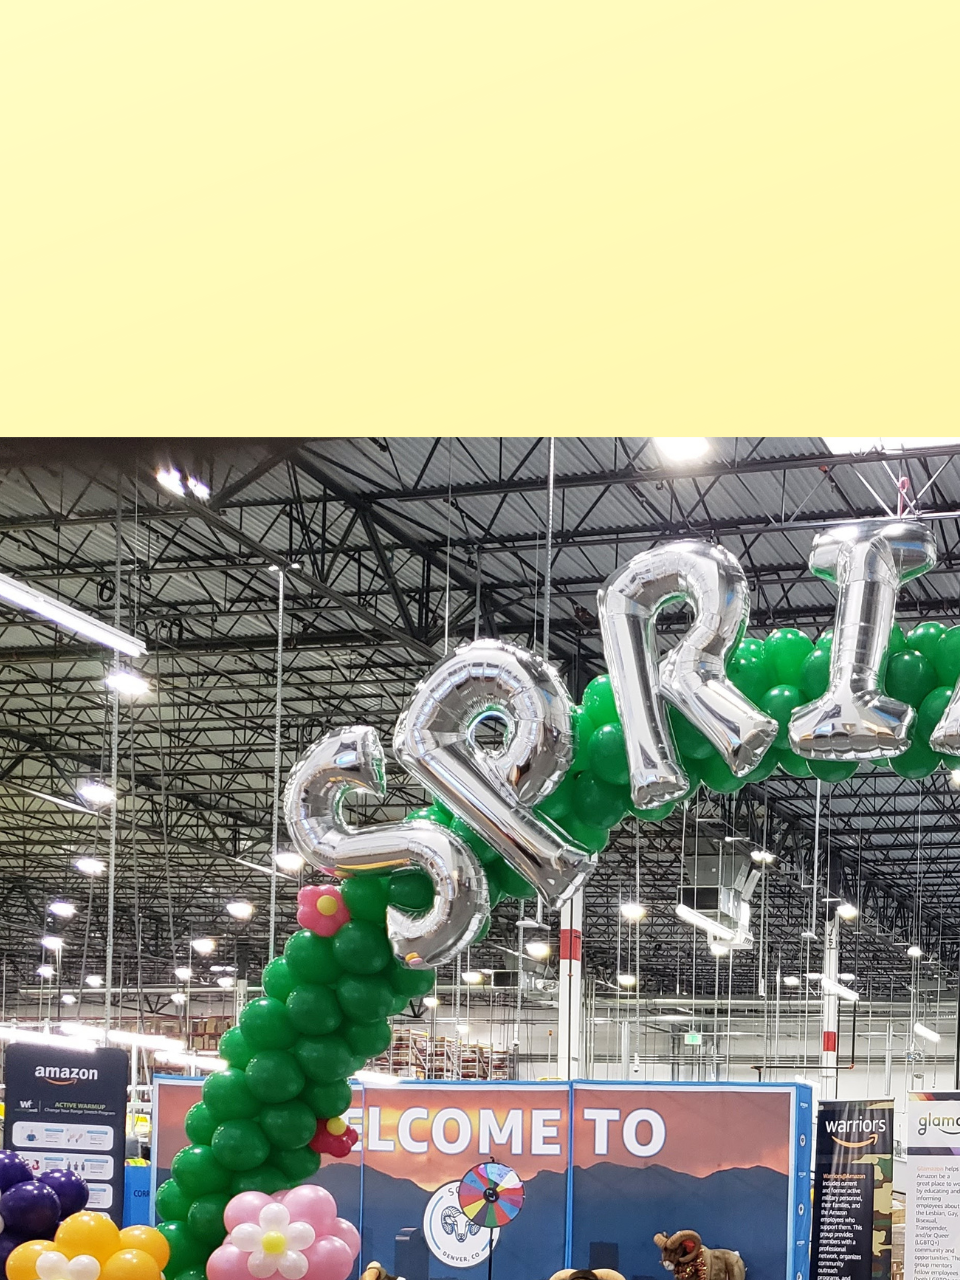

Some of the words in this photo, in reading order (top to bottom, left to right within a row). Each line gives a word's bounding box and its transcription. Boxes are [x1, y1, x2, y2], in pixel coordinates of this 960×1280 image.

[35, 1066, 98, 1080] amazon
[345, 1106, 561, 1156] ELCOME
[582, 1107, 667, 1157] TO
[825, 1116, 886, 1133] warriors
